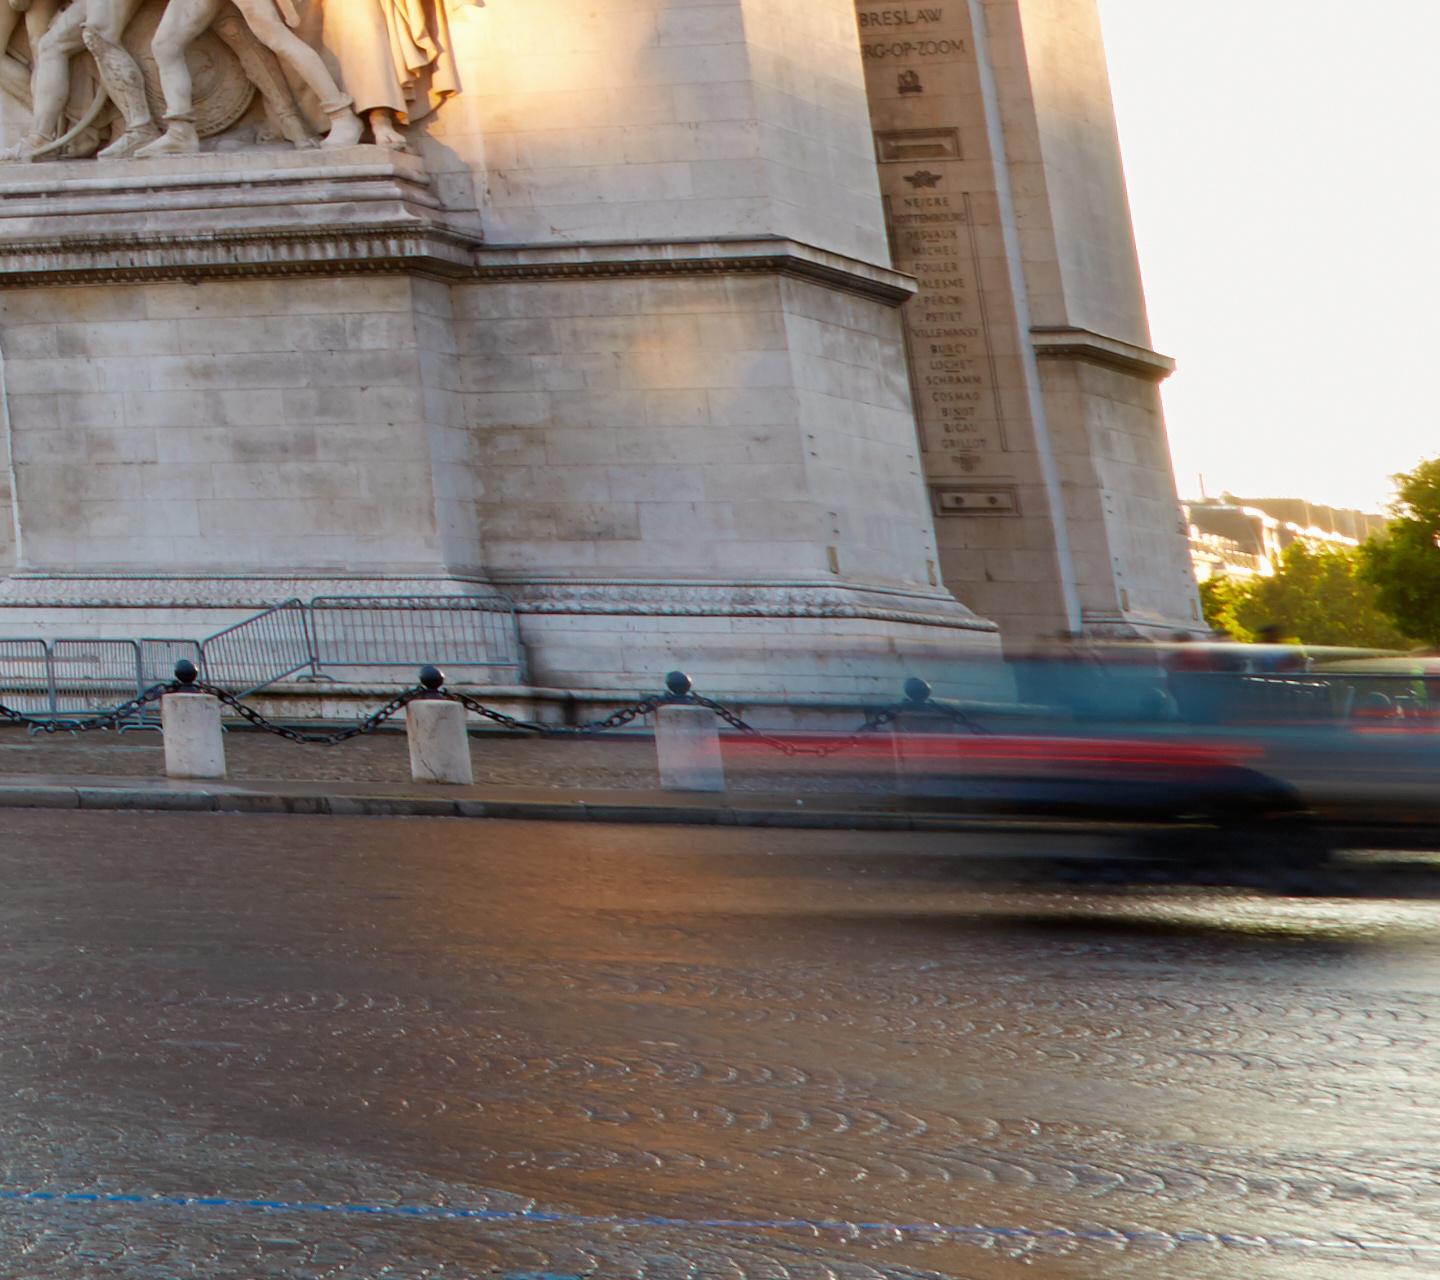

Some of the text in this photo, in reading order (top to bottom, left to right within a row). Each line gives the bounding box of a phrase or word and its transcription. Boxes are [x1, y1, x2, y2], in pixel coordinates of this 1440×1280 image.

[859, 8, 942, 27] BRESLAW
[862, 39, 966, 59] RG-OP-ZOOM
[912, 246, 957, 256] MICHEL
